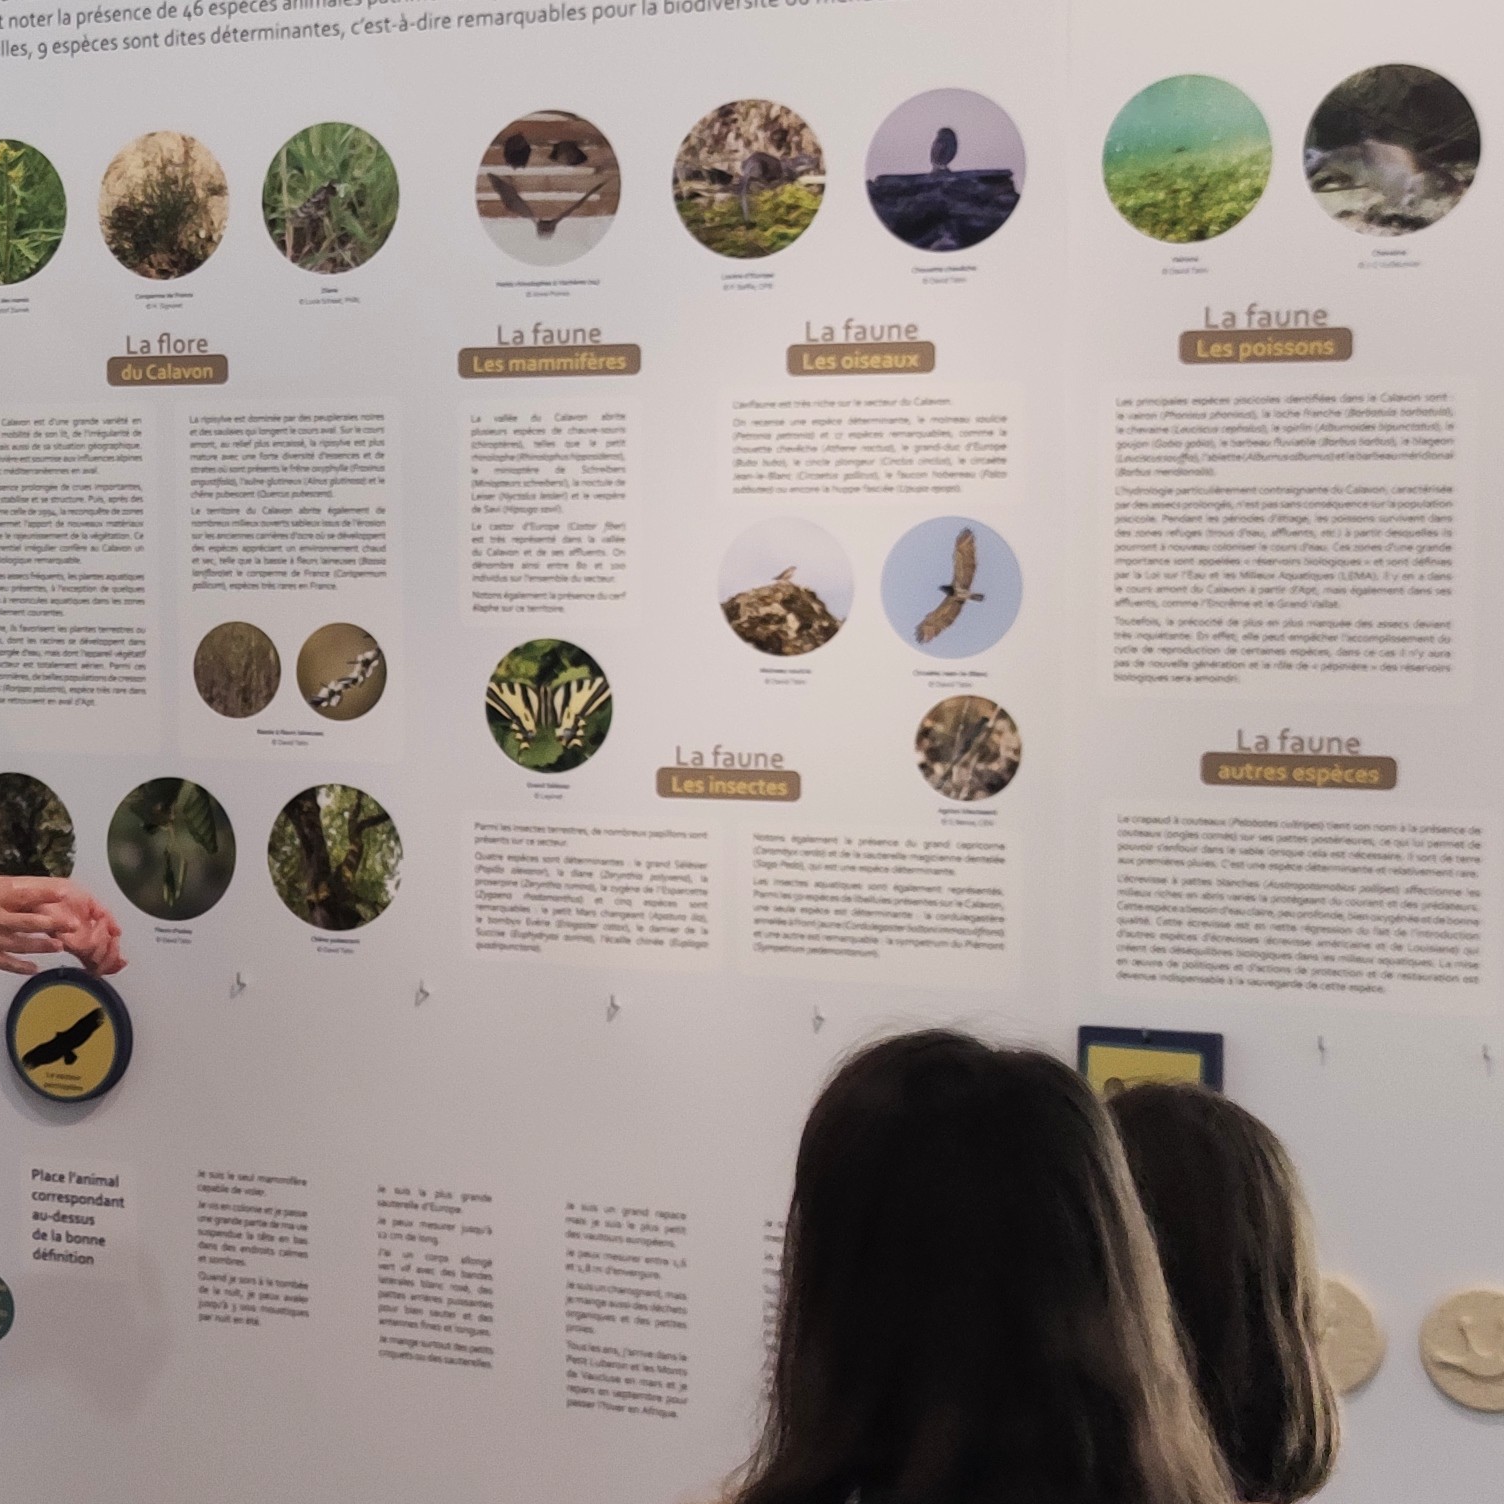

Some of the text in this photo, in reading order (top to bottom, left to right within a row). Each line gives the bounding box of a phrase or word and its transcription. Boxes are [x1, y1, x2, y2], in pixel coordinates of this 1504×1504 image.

[37, 41, 48, 60] 9
[52, 34, 118, 58] espèces
[122, 32, 159, 50] sont
[164, 28, 206, 47] dites
[210, 22, 345, 44] déterminantes,
[456, 2, 587, 29] remarquables
[592, 2, 637, 24] pour
[1204, 302, 1328, 328] La faune
[497, 321, 602, 346] La faune
[805, 317, 924, 344] La faune
[126, 332, 208, 355] La flore
[1196, 339, 1335, 362] Les poissons
[121, 362, 213, 380] du Calavon
[473, 351, 627, 372] Les mammifères
[802, 350, 919, 370] Les oiseaux
[1237, 727, 1361, 754] La faune
[676, 744, 784, 767] La faune
[671, 775, 788, 796] Les insectes
[1217, 763, 1380, 789] autres espèces
[31, 1168, 65, 1183] Place
[31, 1191, 125, 1208] correspondant
[32, 1209, 95, 1226] au-dessus
[32, 1227, 106, 1247] de la bonne
[32, 1248, 94, 1265] définition
